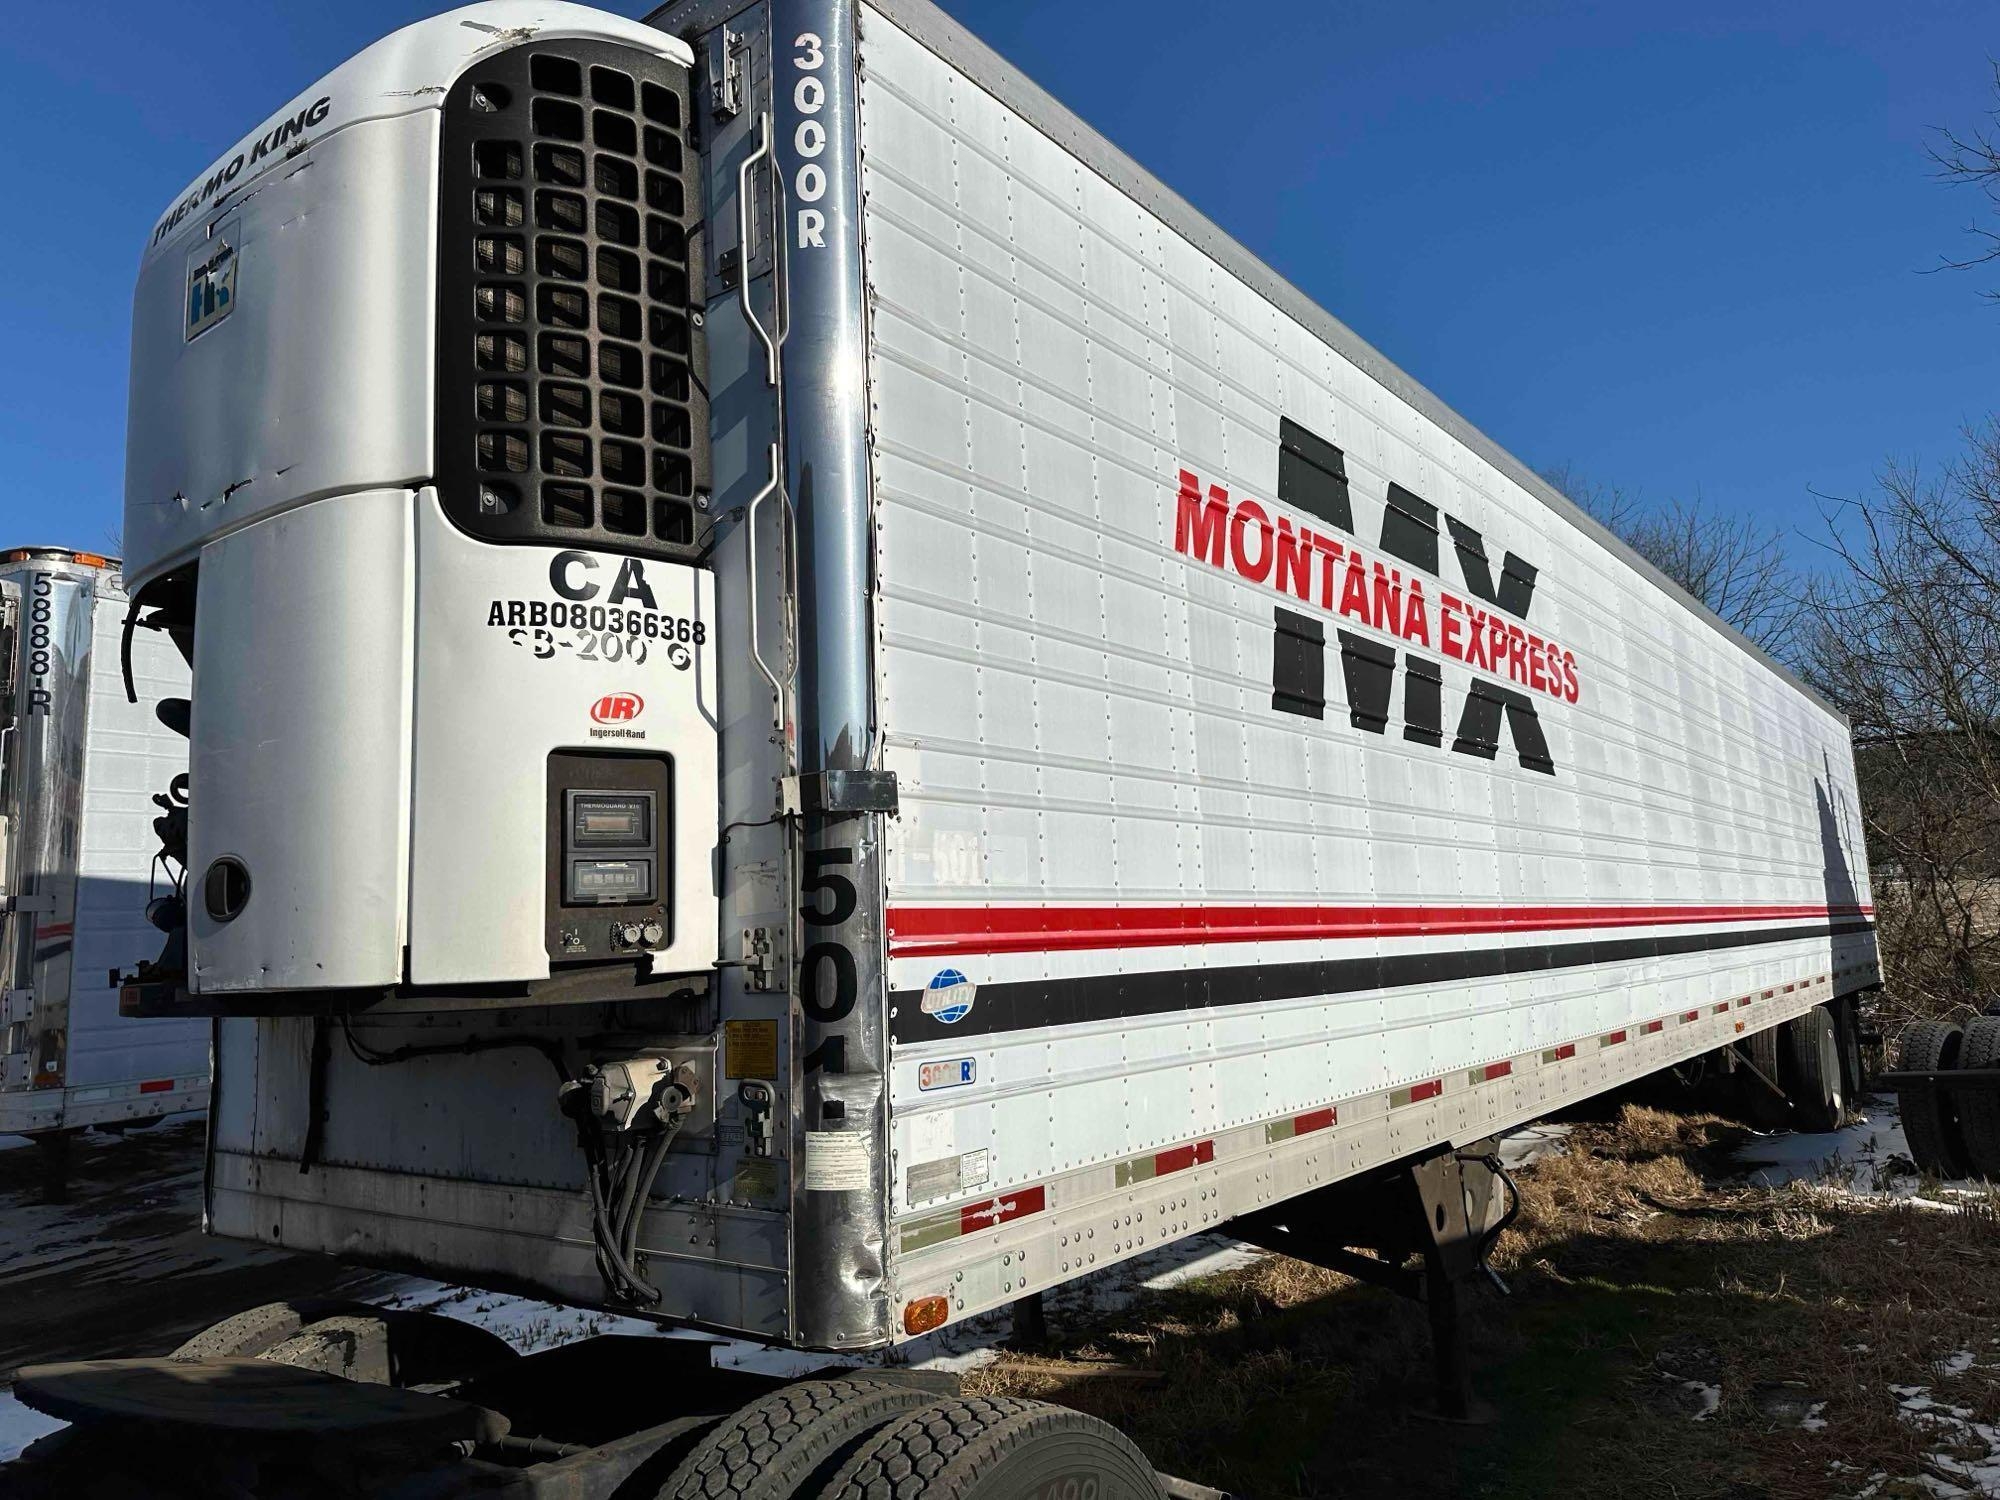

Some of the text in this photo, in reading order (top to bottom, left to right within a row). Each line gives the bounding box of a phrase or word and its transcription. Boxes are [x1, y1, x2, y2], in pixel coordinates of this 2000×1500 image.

[249, 95, 331, 168] KING
[793, 32, 827, 249] 3000R
[487, 600, 706, 645] ARB080366368
[549, 550, 658, 609] CA
[1174, 468, 1580, 705] MONTANA EXPRESS
[27, 572, 52, 715] 5888-R
[599, 696, 637, 720] IR
[799, 847, 858, 1119] 501
